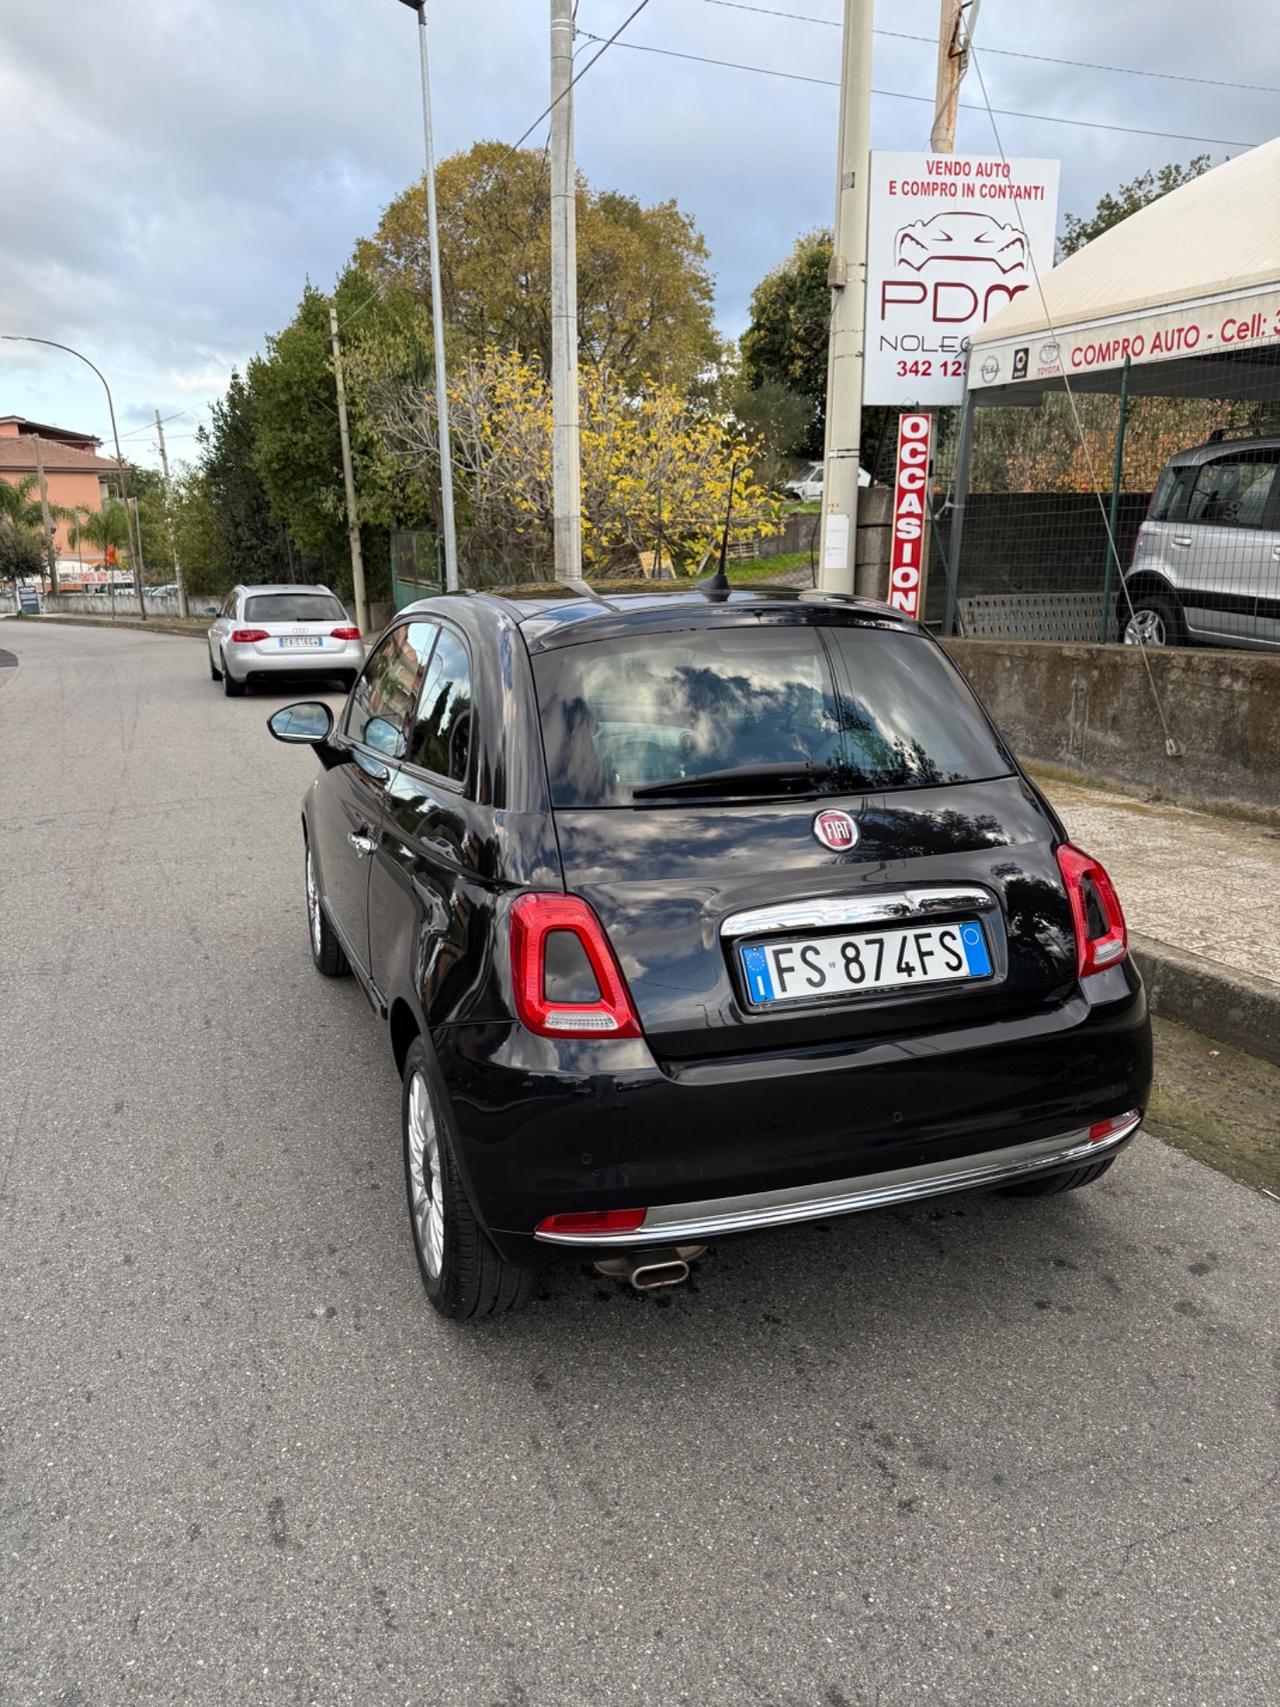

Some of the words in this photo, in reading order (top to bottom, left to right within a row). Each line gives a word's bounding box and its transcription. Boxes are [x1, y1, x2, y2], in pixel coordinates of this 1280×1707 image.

[926, 160, 971, 177] VENDO
[975, 163, 1011, 178] AUTO
[889, 180, 897, 195] E
[901, 180, 958, 197] COMPRO
[962, 183, 975, 198] IN
[979, 184, 1044, 200] CONTANTI
[1071, 335, 1145, 367] COMPRO
[1150, 325, 1200, 354] AUTO
[1221, 312, 1267, 342] Cell:
[896, 359, 932, 377] 342
[1037, 365, 1060, 376] TOYOTA
[823, 820, 850, 840] FIAT
[772, 945, 826, 992] FS
[840, 930, 963, 984] 874FS
